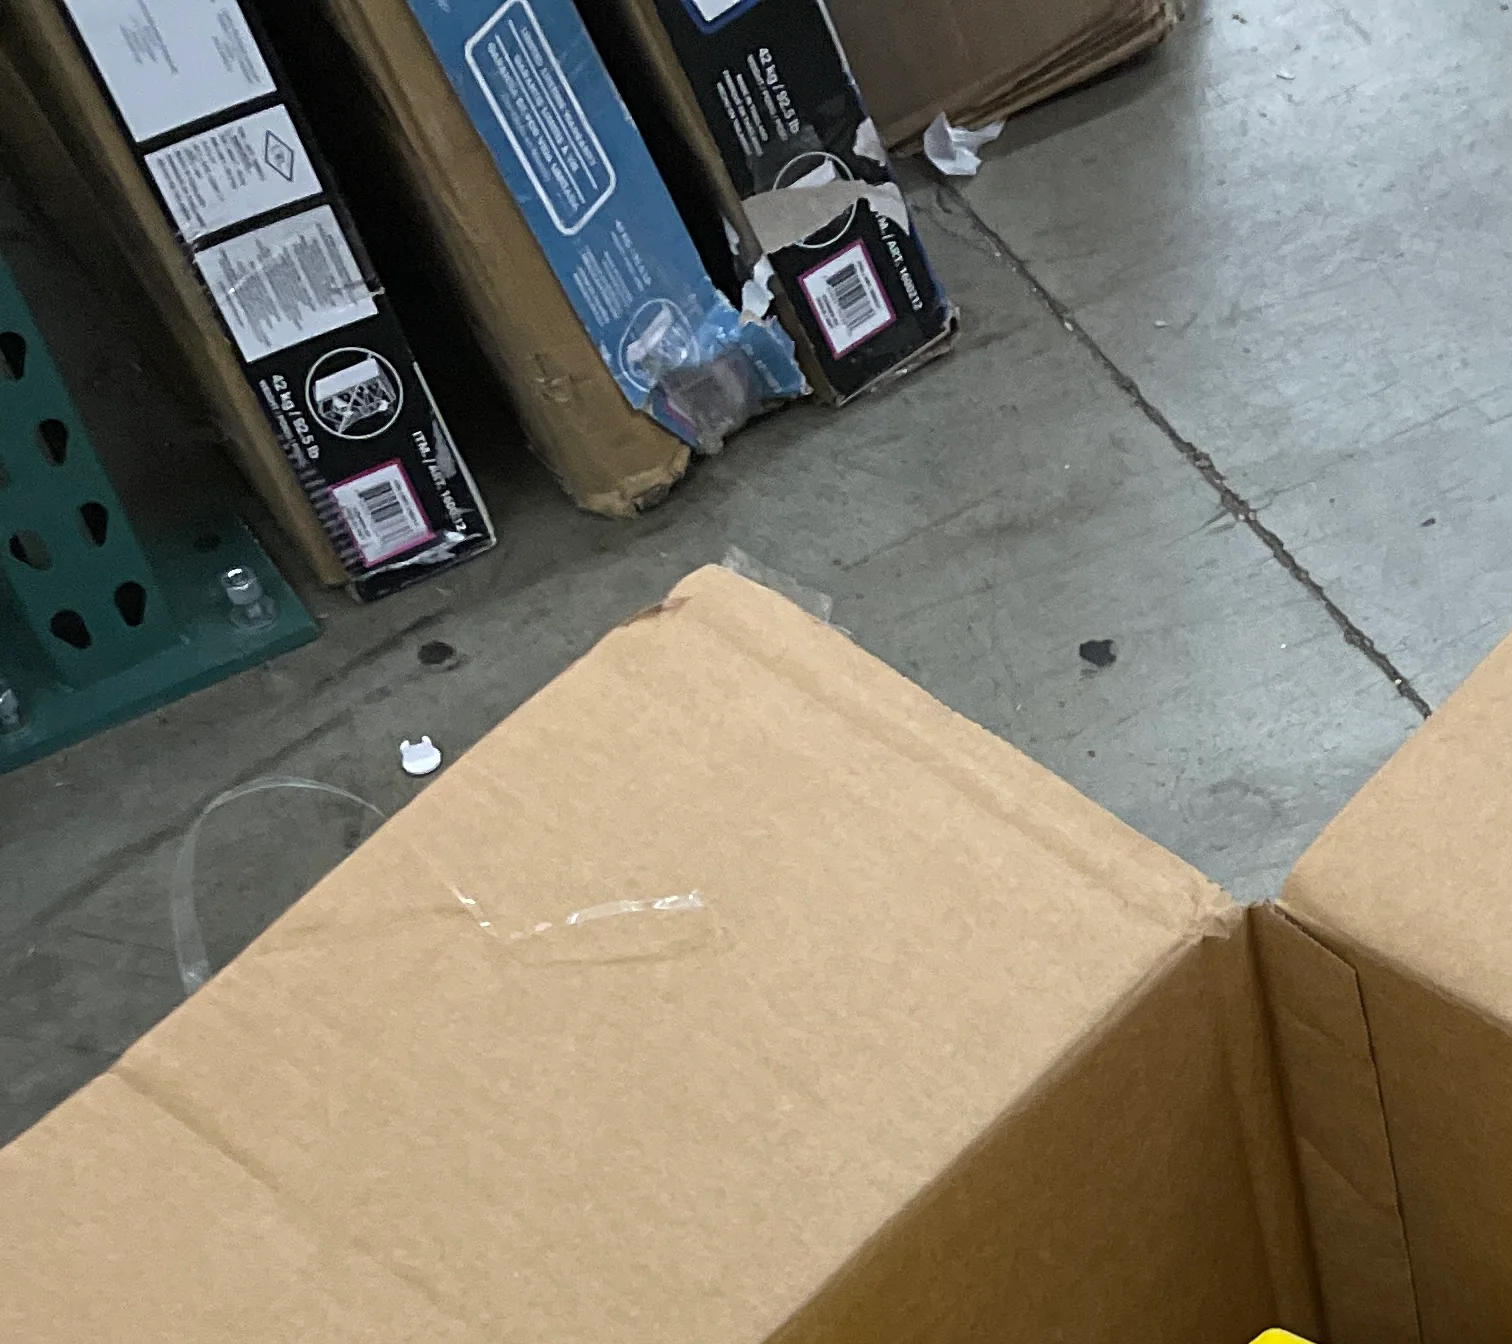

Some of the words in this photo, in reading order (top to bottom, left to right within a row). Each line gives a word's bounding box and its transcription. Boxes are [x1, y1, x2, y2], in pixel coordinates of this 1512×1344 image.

[759, 48, 773, 66] 42
[766, 64, 778, 85] kg
[776, 90, 796, 119] 92.5
[788, 118, 800, 134] lb
[272, 374, 288, 391] 42
[280, 391, 296, 411] kg
[306, 444, 320, 459] lb
